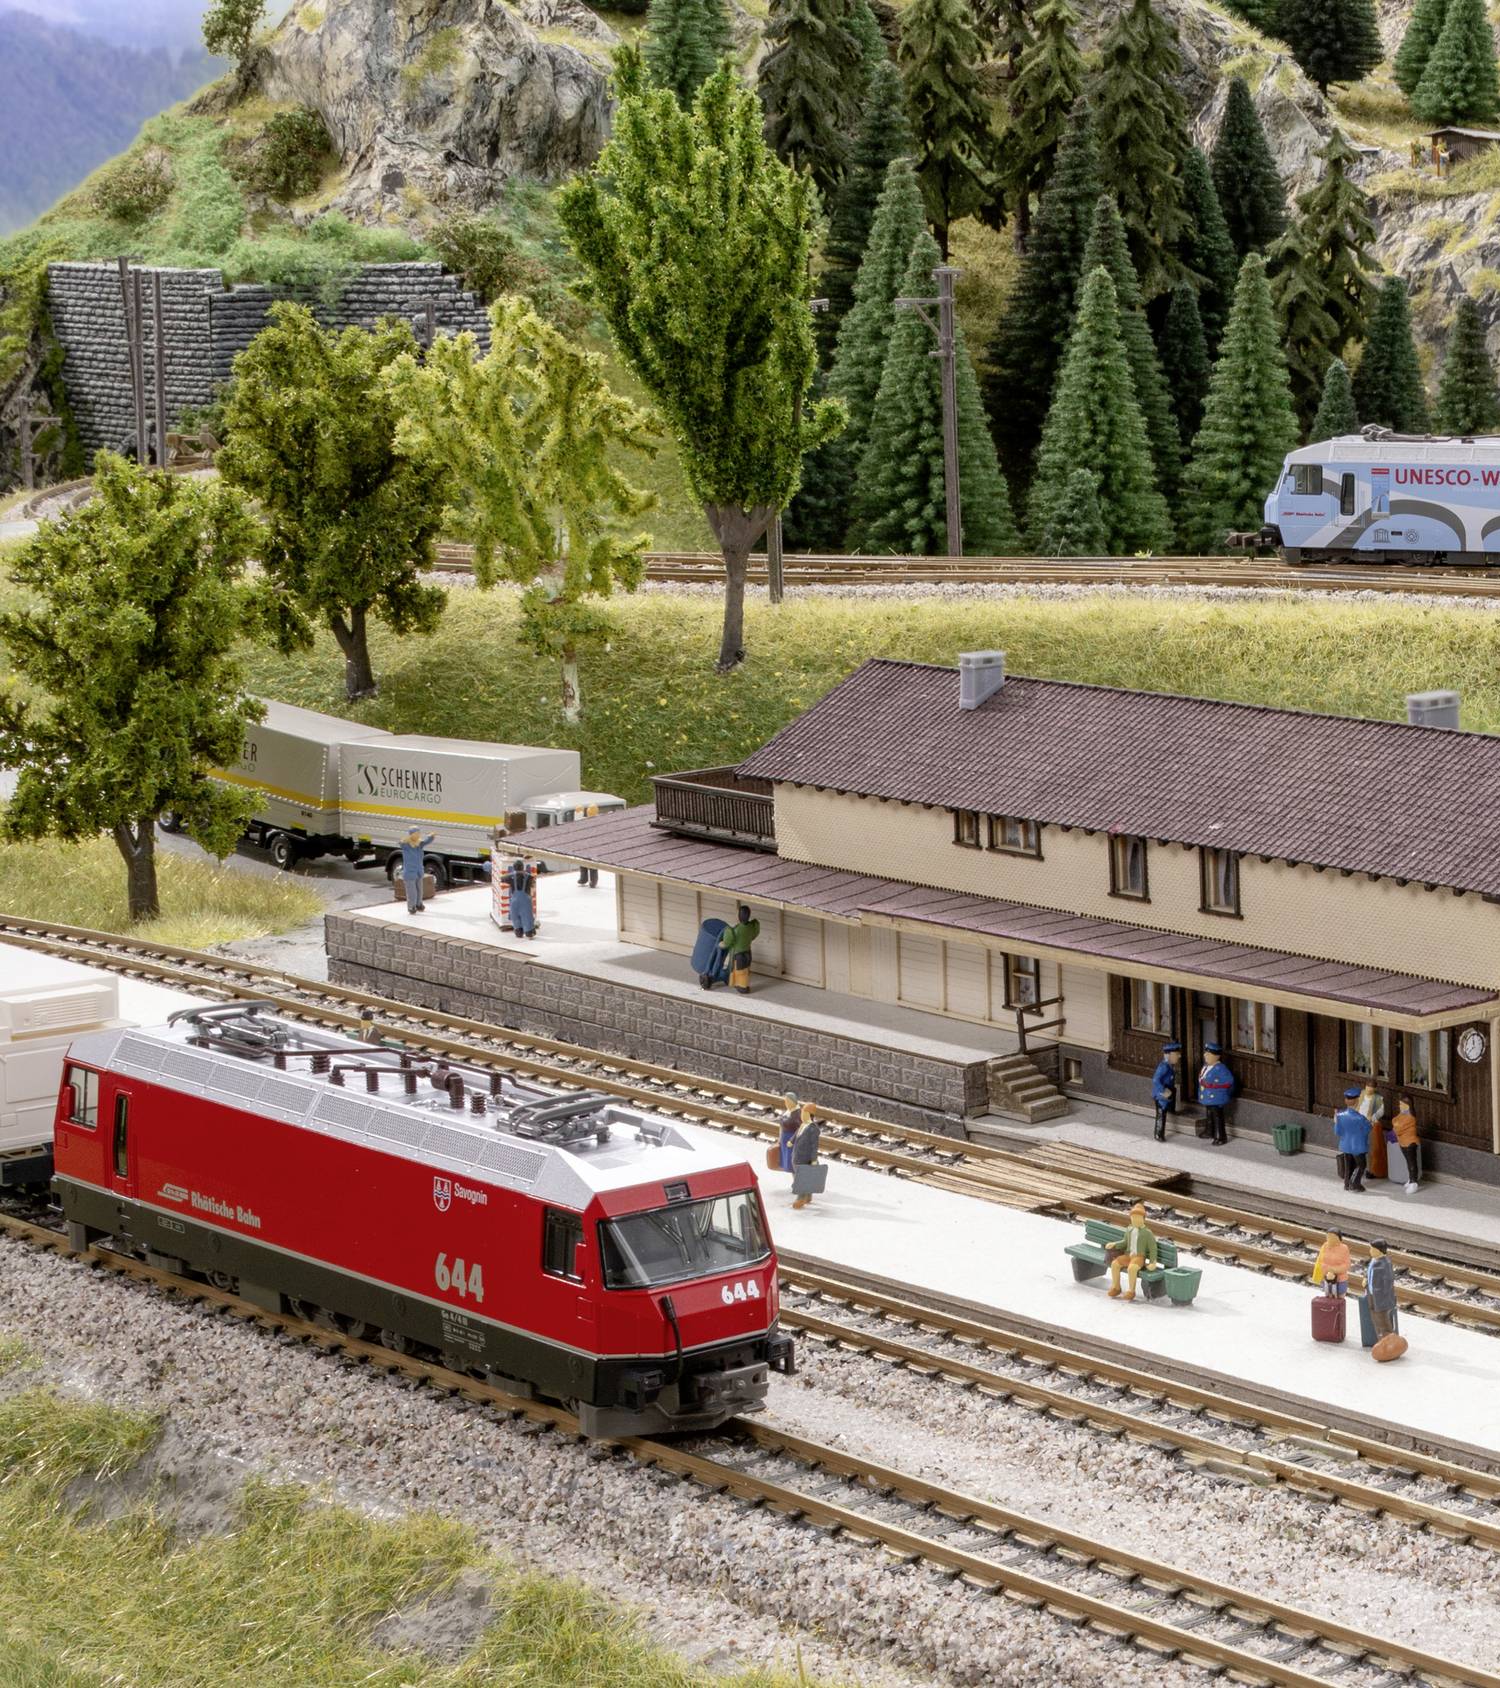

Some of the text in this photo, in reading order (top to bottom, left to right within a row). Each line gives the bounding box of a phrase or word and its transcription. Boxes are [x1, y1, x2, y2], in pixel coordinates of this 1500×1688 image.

[381, 767, 442, 793] SCHENKER
[380, 787, 441, 804] EUROCARGO
[454, 1182, 488, 1205] Savognin
[191, 1191, 234, 1220] Rhätische
[236, 1206, 261, 1229] Bahn
[435, 1252, 484, 1303] 644
[721, 1279, 760, 1305] 644
